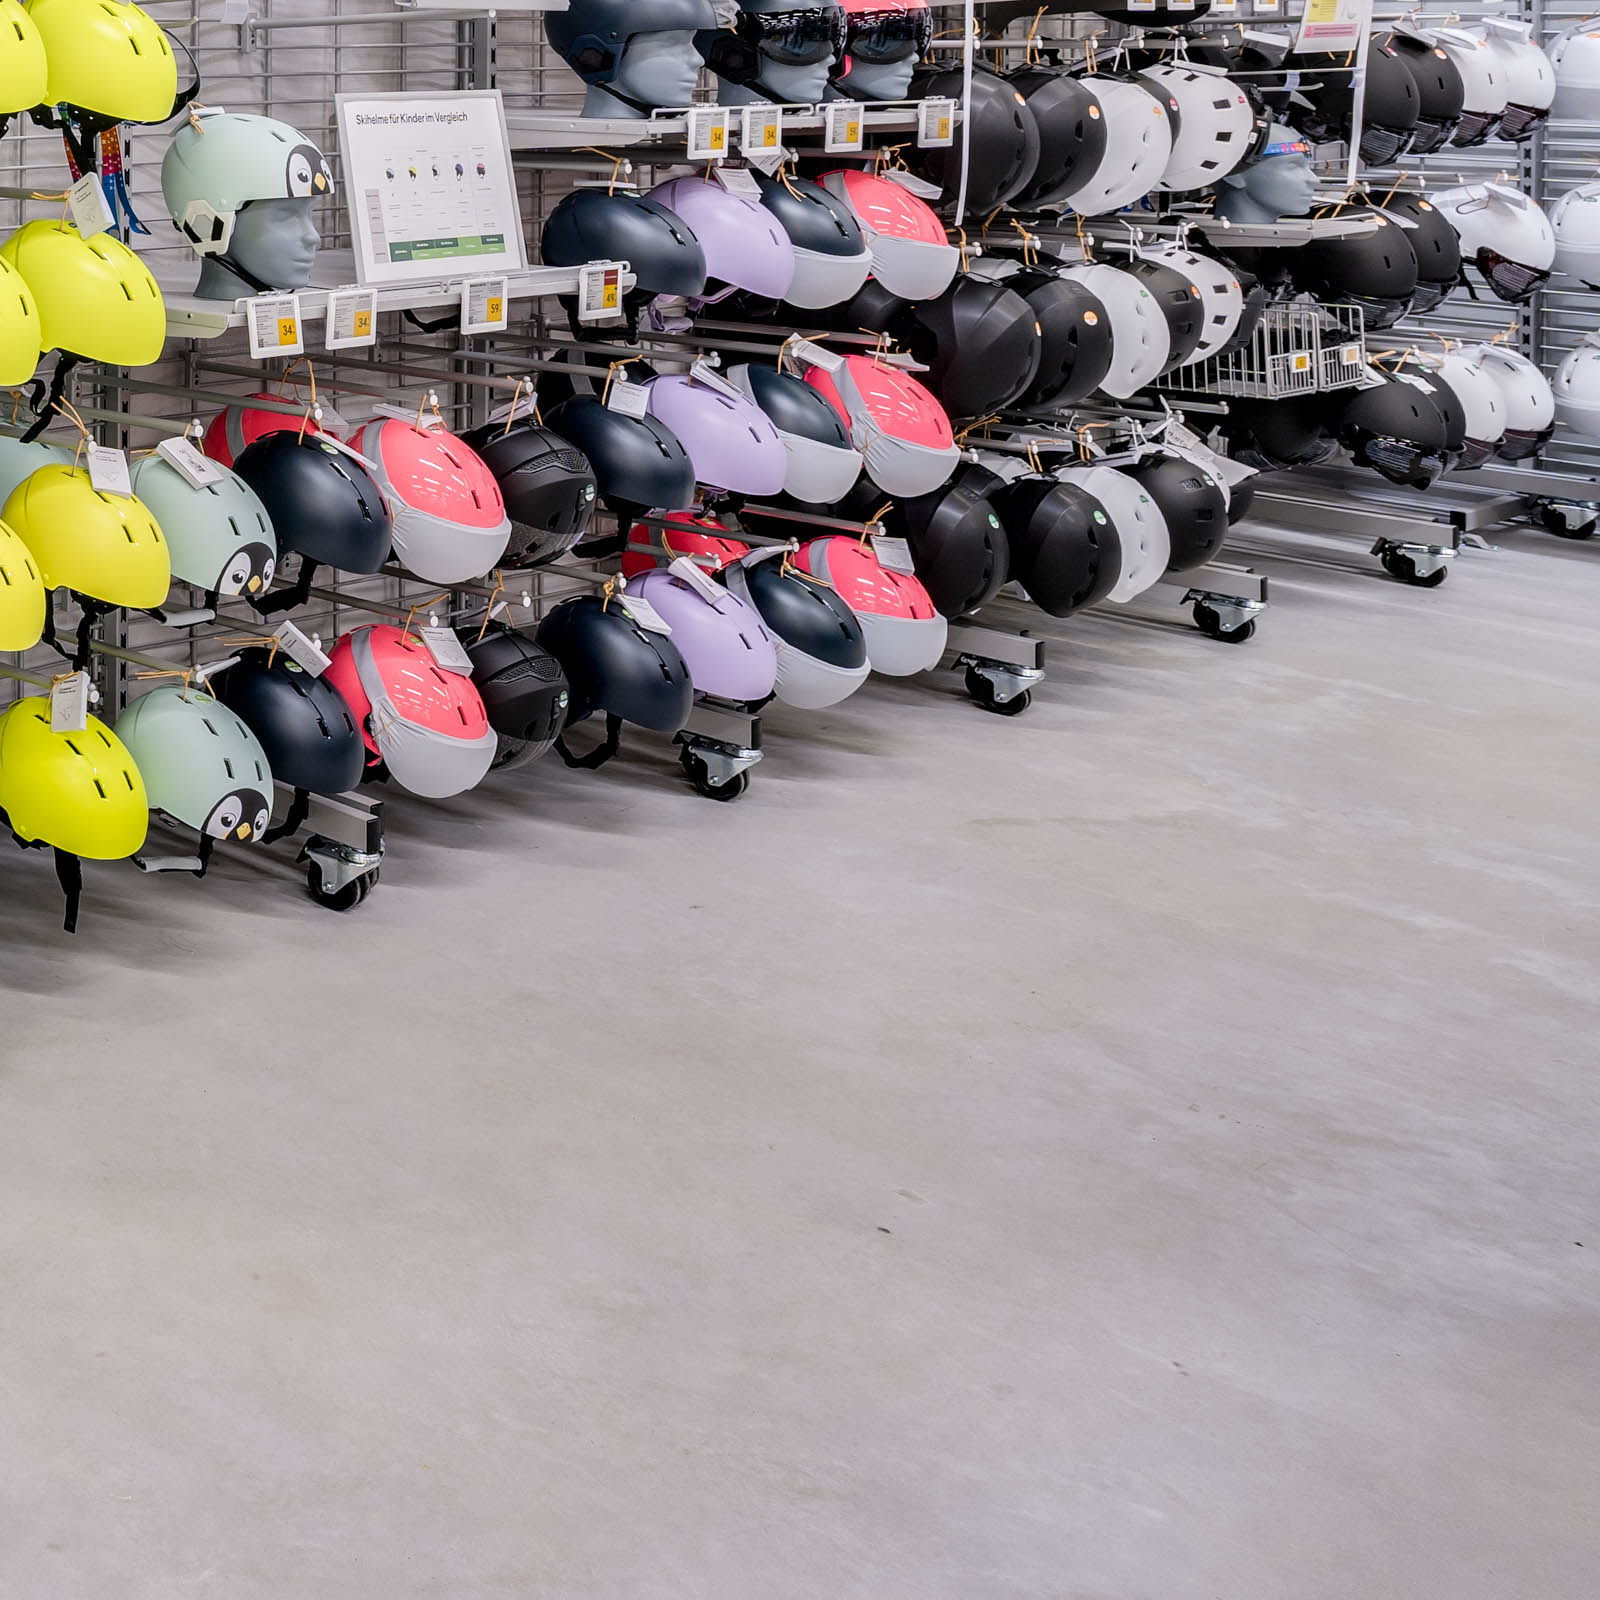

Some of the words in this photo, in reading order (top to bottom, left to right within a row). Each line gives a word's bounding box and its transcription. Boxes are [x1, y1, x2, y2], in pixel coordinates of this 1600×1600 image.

[356, 113, 388, 126] Skihelme
[389, 113, 400, 124] für
[400, 113, 424, 124] Kinder
[425, 112, 434, 123] im
[435, 112, 468, 125] Vergleich
